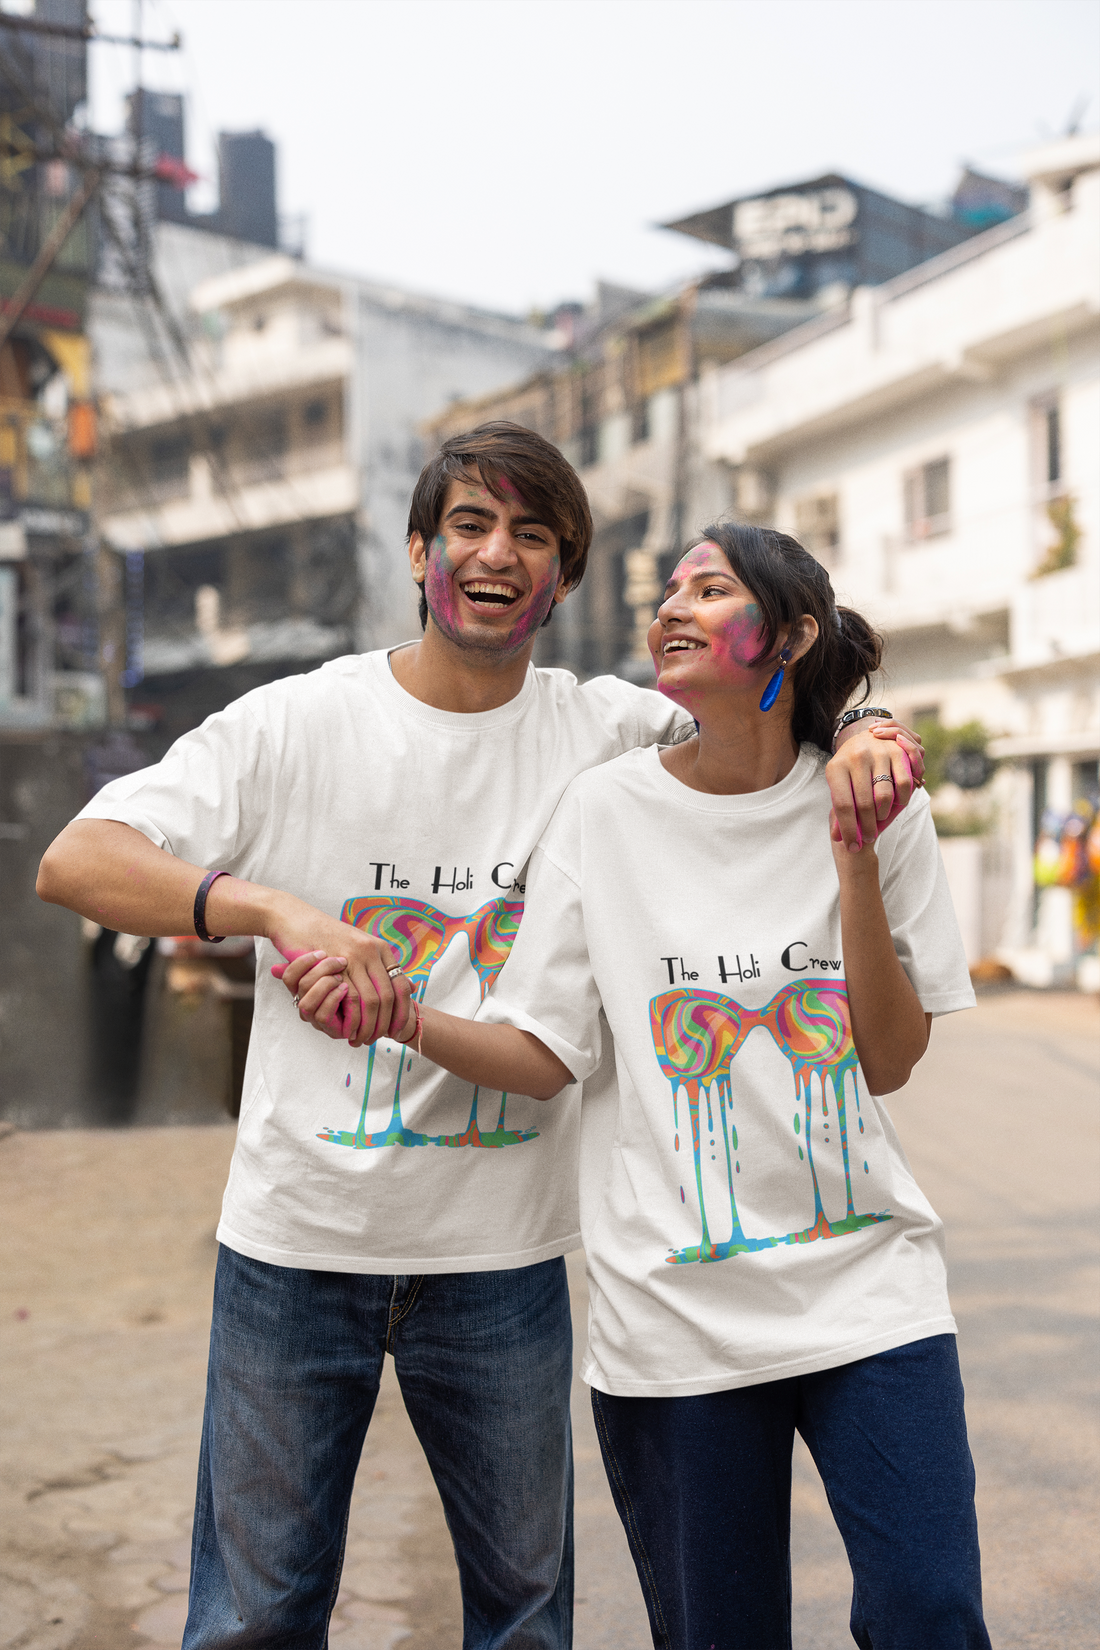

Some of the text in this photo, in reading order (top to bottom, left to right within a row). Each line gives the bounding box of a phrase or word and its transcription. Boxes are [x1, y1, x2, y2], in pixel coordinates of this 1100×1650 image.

[369, 862, 525, 894] The Holi Cre
[660, 941, 842, 985] The Holi Crew
